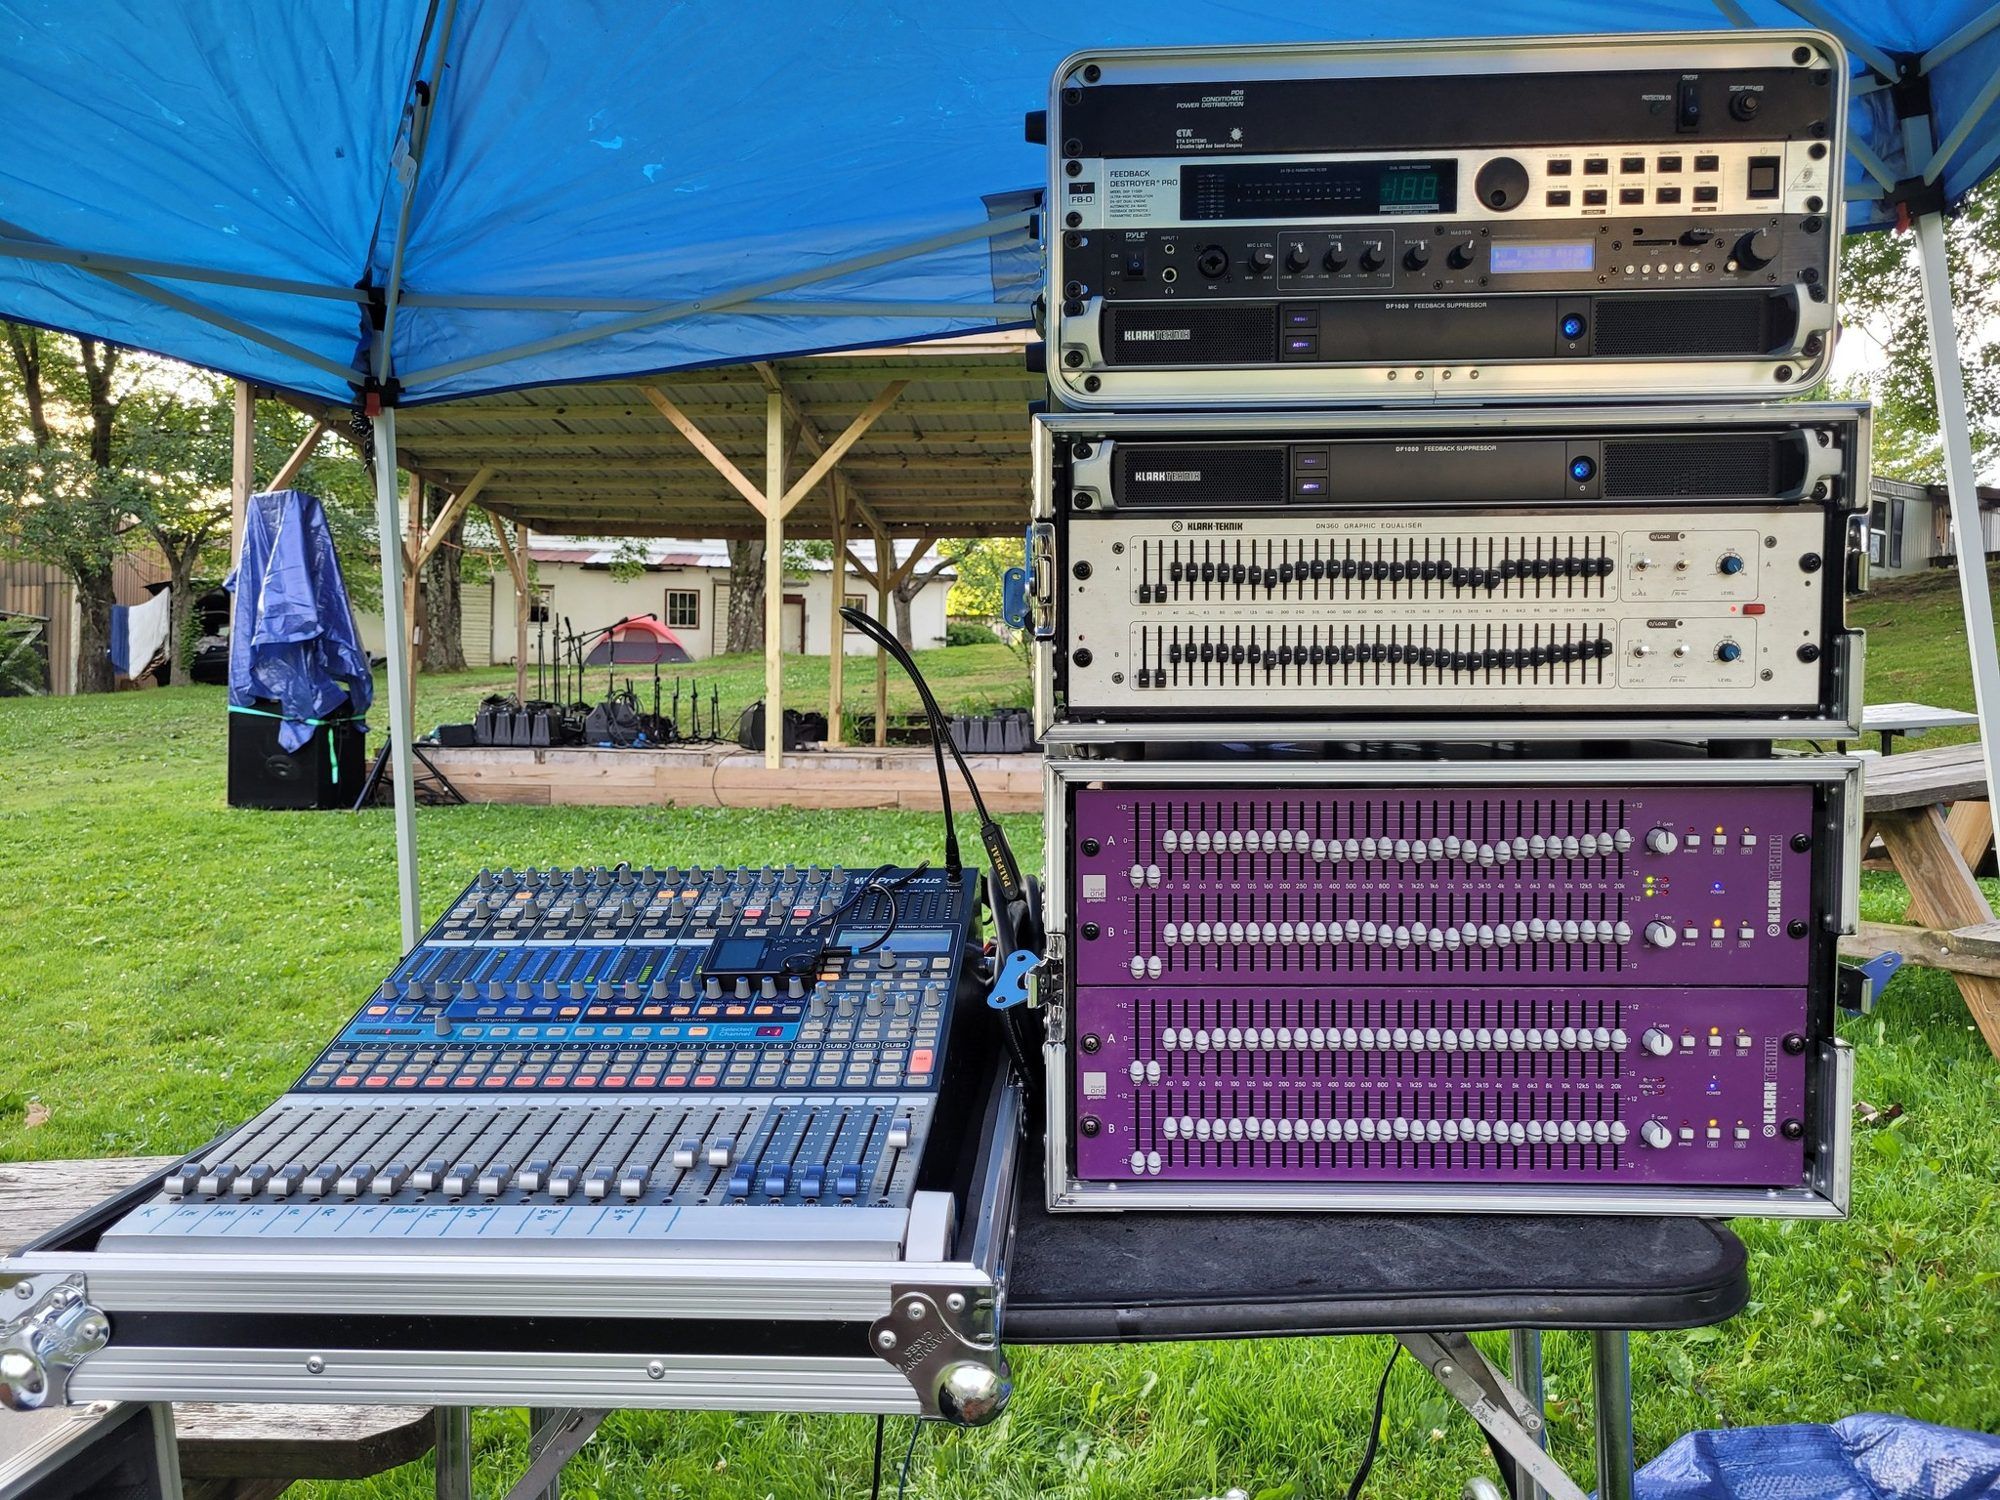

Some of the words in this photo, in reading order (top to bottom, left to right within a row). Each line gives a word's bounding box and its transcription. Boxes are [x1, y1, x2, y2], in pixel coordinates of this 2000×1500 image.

[1187, 522, 1243, 531] KLARK-TEKNIK
[1107, 836, 1115, 845] A
[990, 844, 1011, 888] PALPEAL
[876, 877, 942, 885] Preonus
[1108, 927, 1115, 937] B
[1107, 1034, 1115, 1043] A
[1108, 1124, 1115, 1133] B
